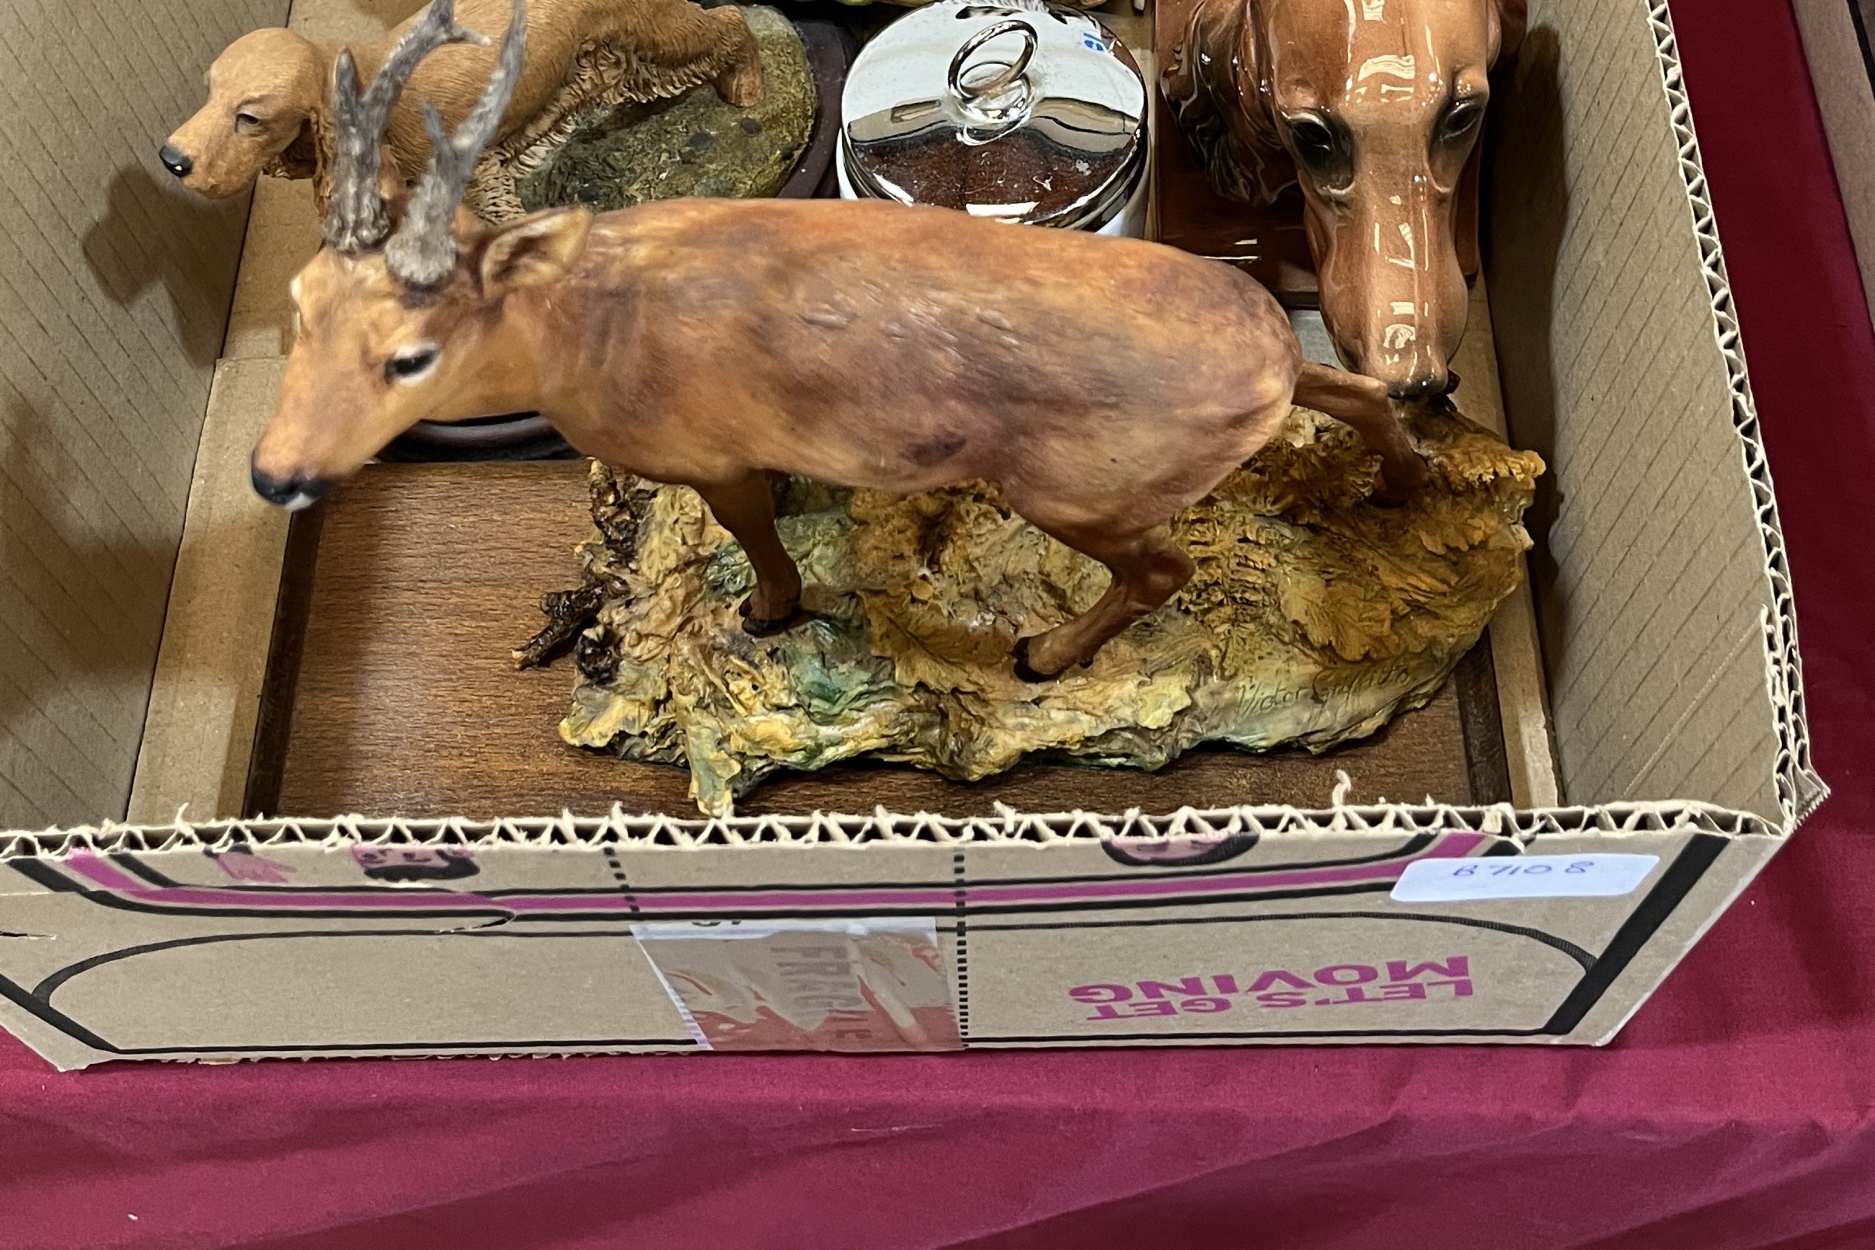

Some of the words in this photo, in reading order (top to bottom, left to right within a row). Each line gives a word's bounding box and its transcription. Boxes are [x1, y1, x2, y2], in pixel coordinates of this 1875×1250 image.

[1068, 955, 1469, 1005] MOVING
[1256, 978, 1474, 1008] LET'S
[1086, 996, 1232, 1021] GET
